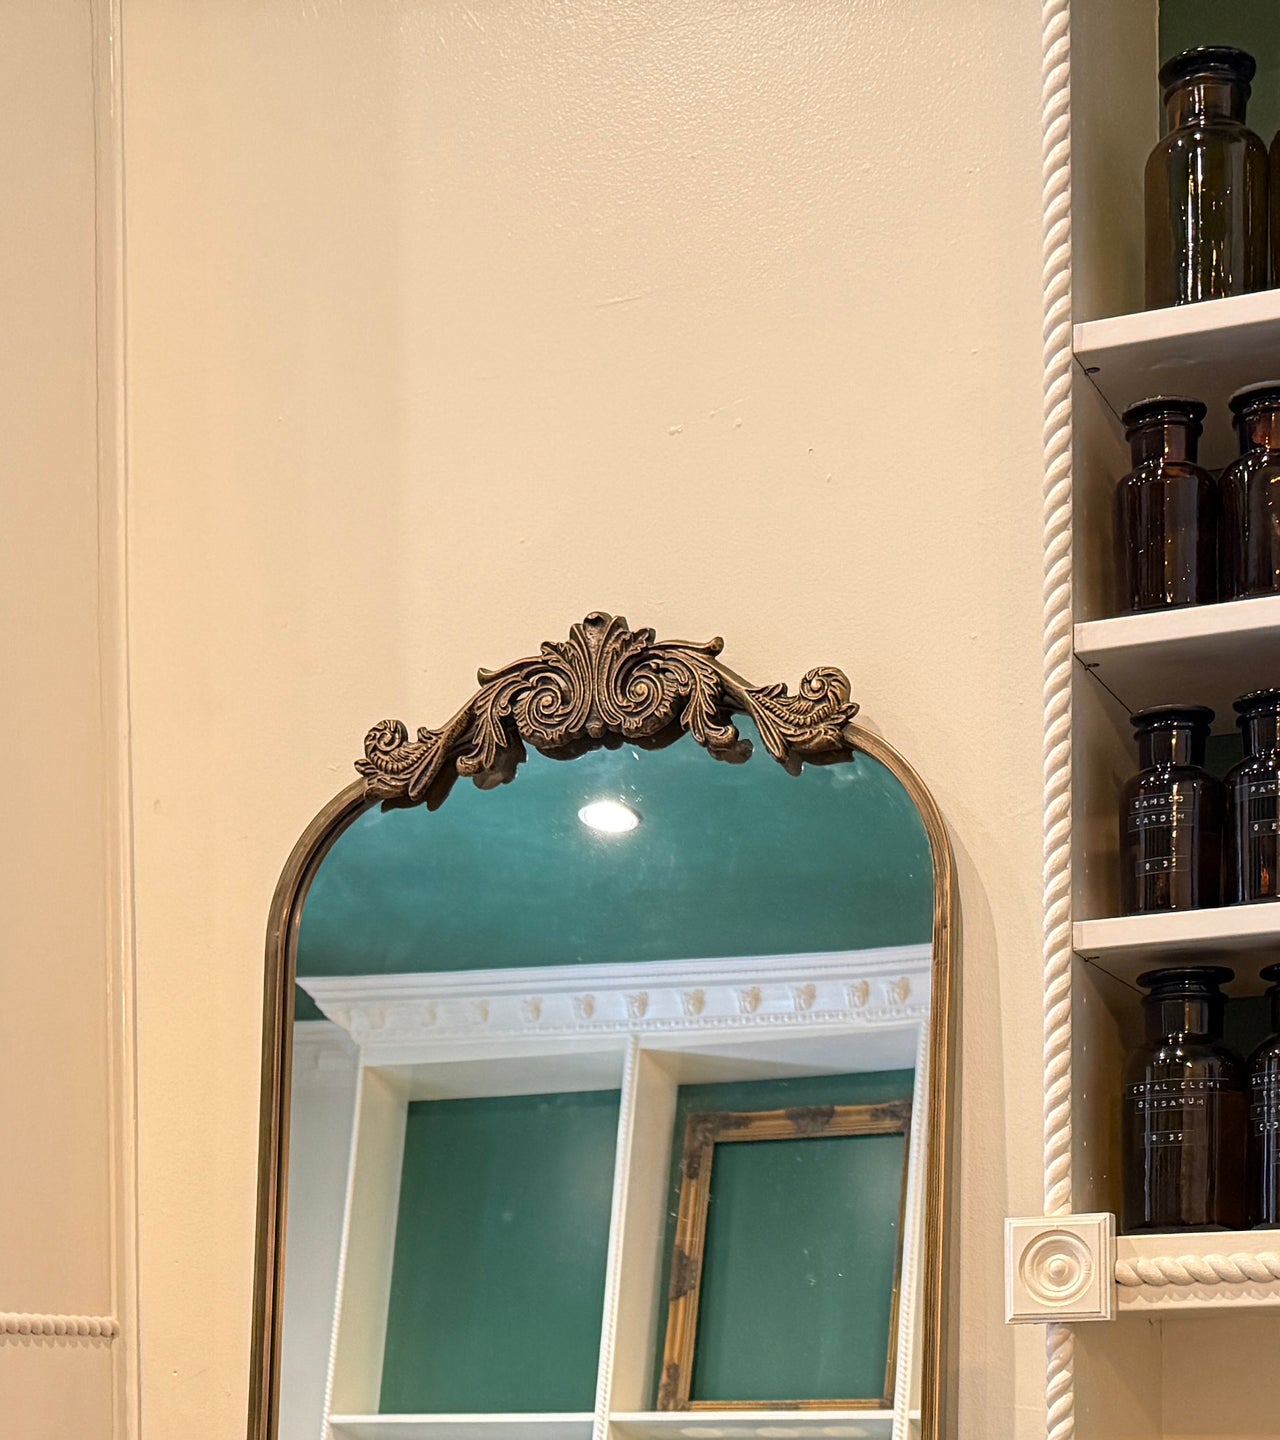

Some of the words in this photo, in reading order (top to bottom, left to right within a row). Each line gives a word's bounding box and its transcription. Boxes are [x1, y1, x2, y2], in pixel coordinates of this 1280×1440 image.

[1134, 795, 1184, 809] BAMBOO
[1145, 859, 1176, 871] 0.3
[1138, 1097, 1205, 1108] OLIBANUM
